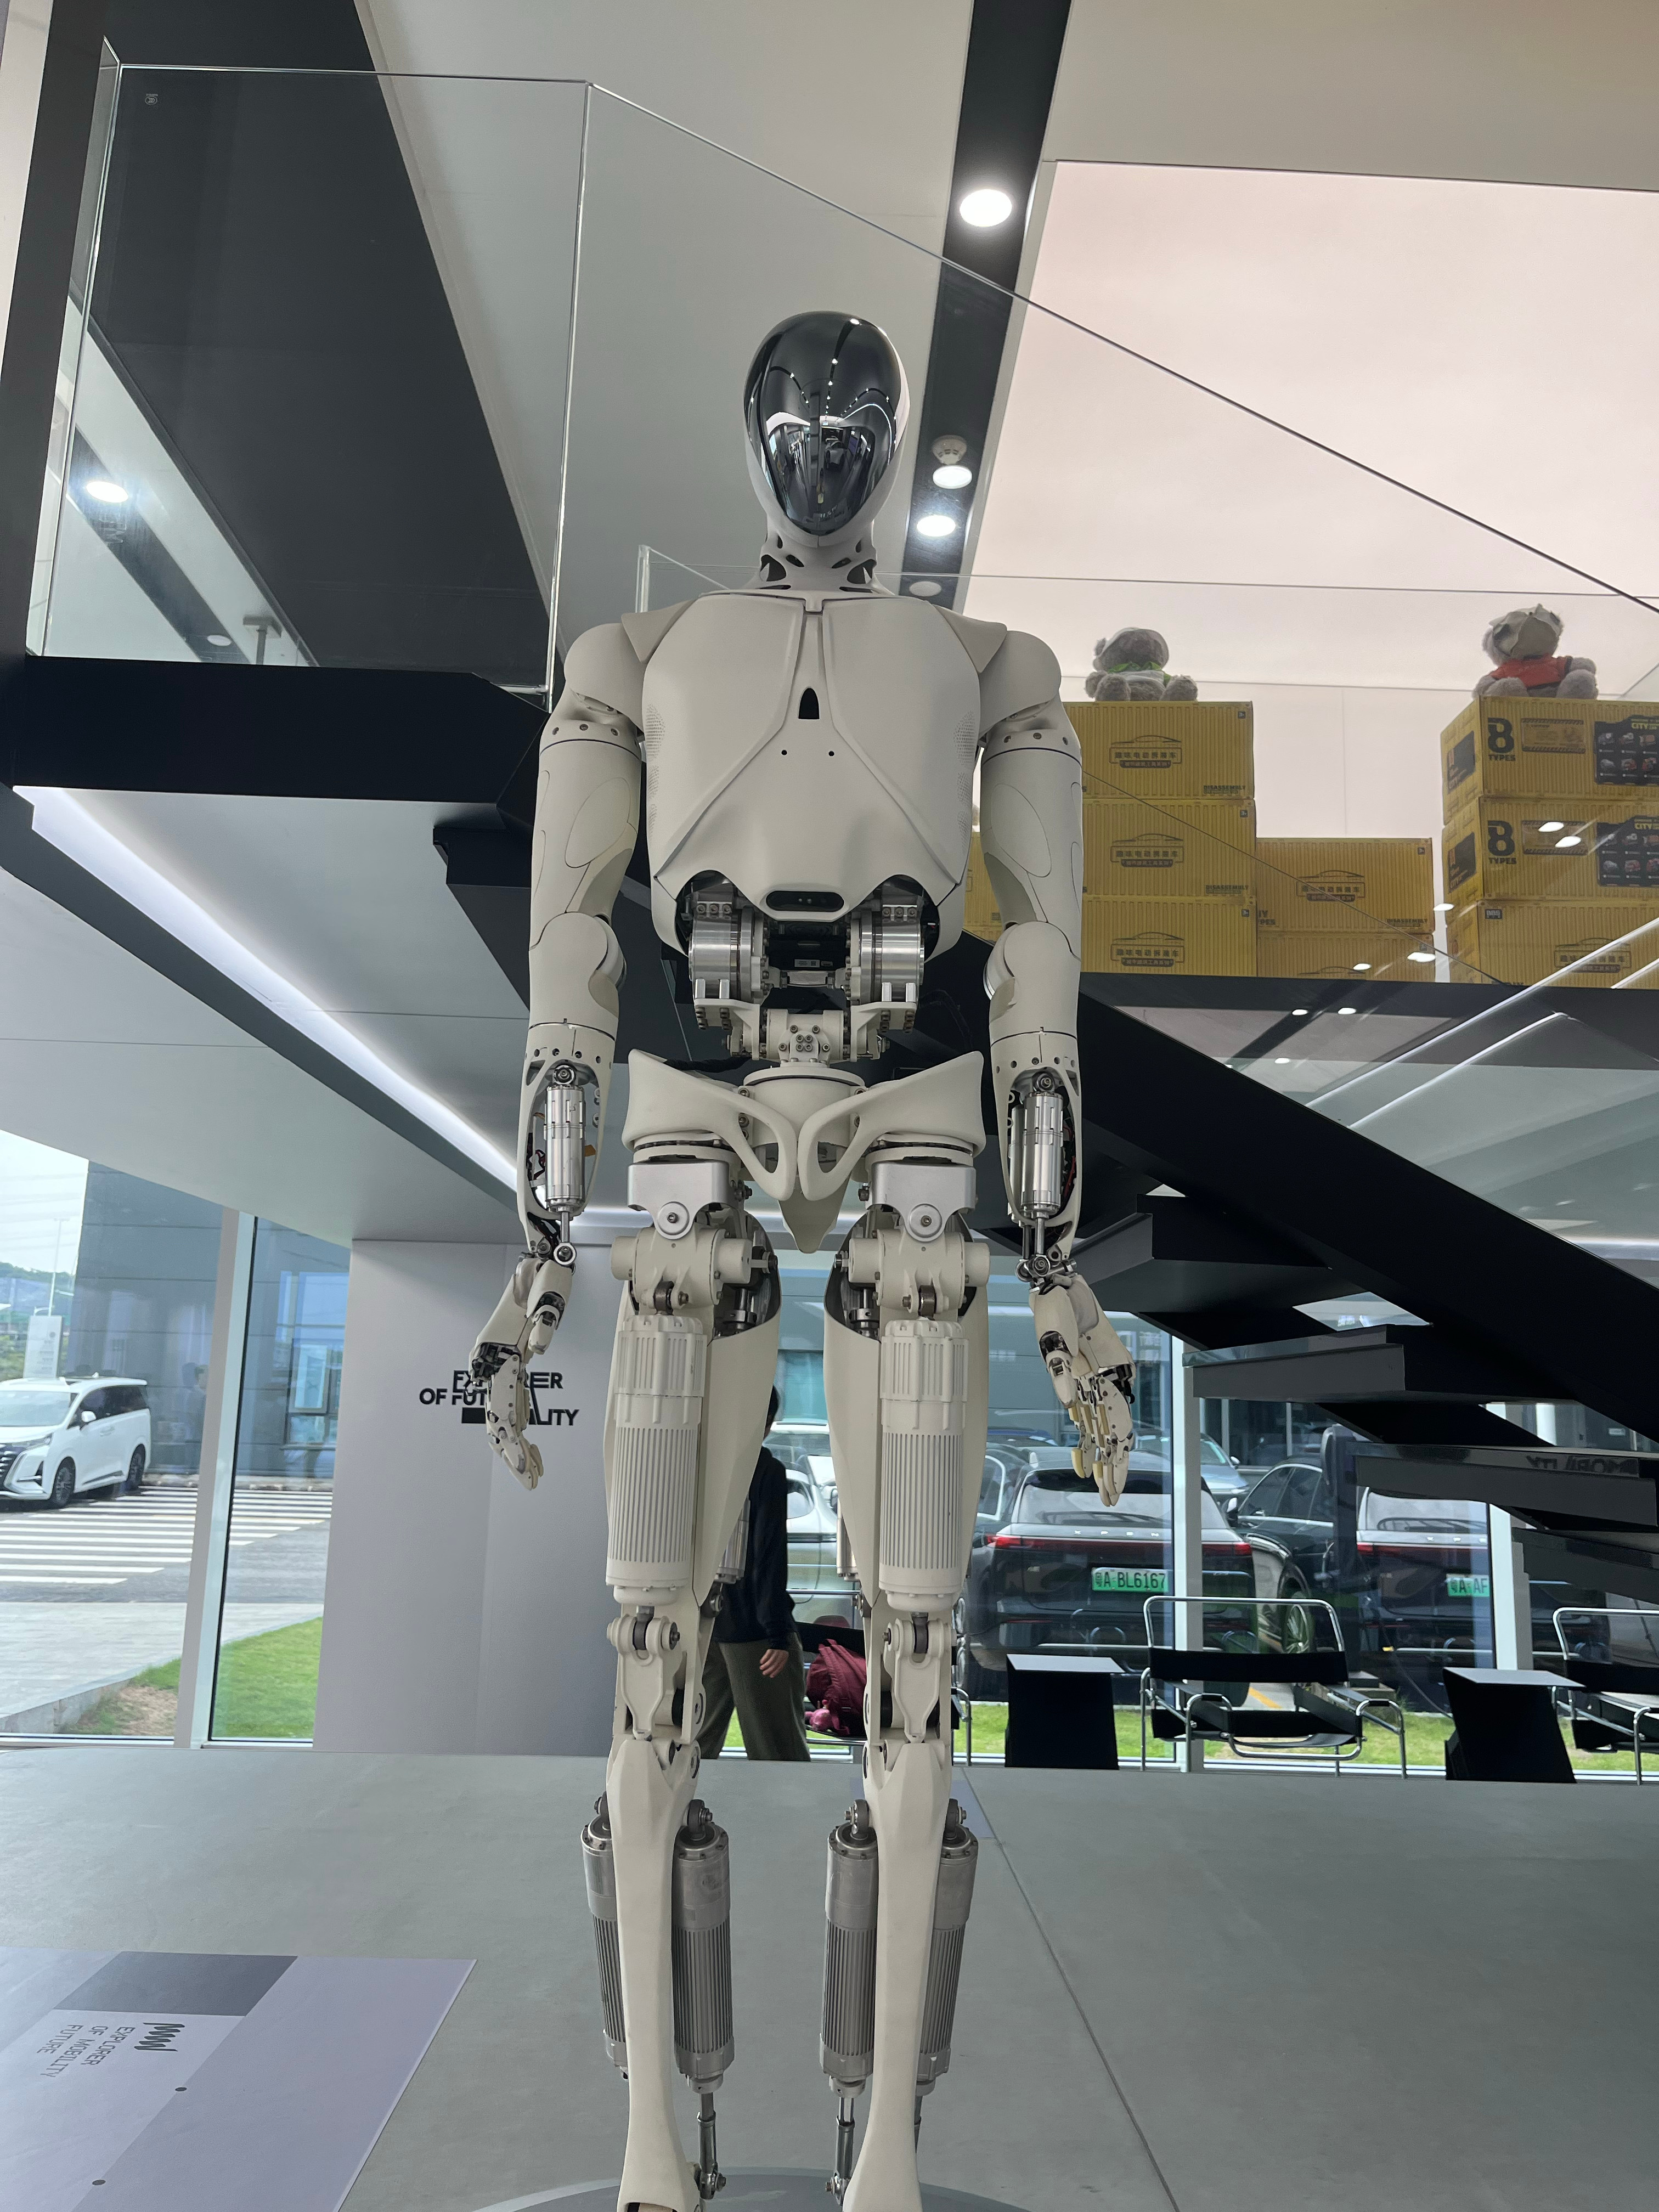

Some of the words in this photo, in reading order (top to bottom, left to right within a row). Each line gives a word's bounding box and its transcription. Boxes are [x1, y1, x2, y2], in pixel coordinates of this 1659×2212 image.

[419, 1388, 448, 1405] OF
[37, 2024, 83, 2054] FUTURE
[88, 2025, 109, 2036] OF
[40, 2039, 95, 2078] MOBILITY
[81, 2027, 136, 2065] EXPLORER
